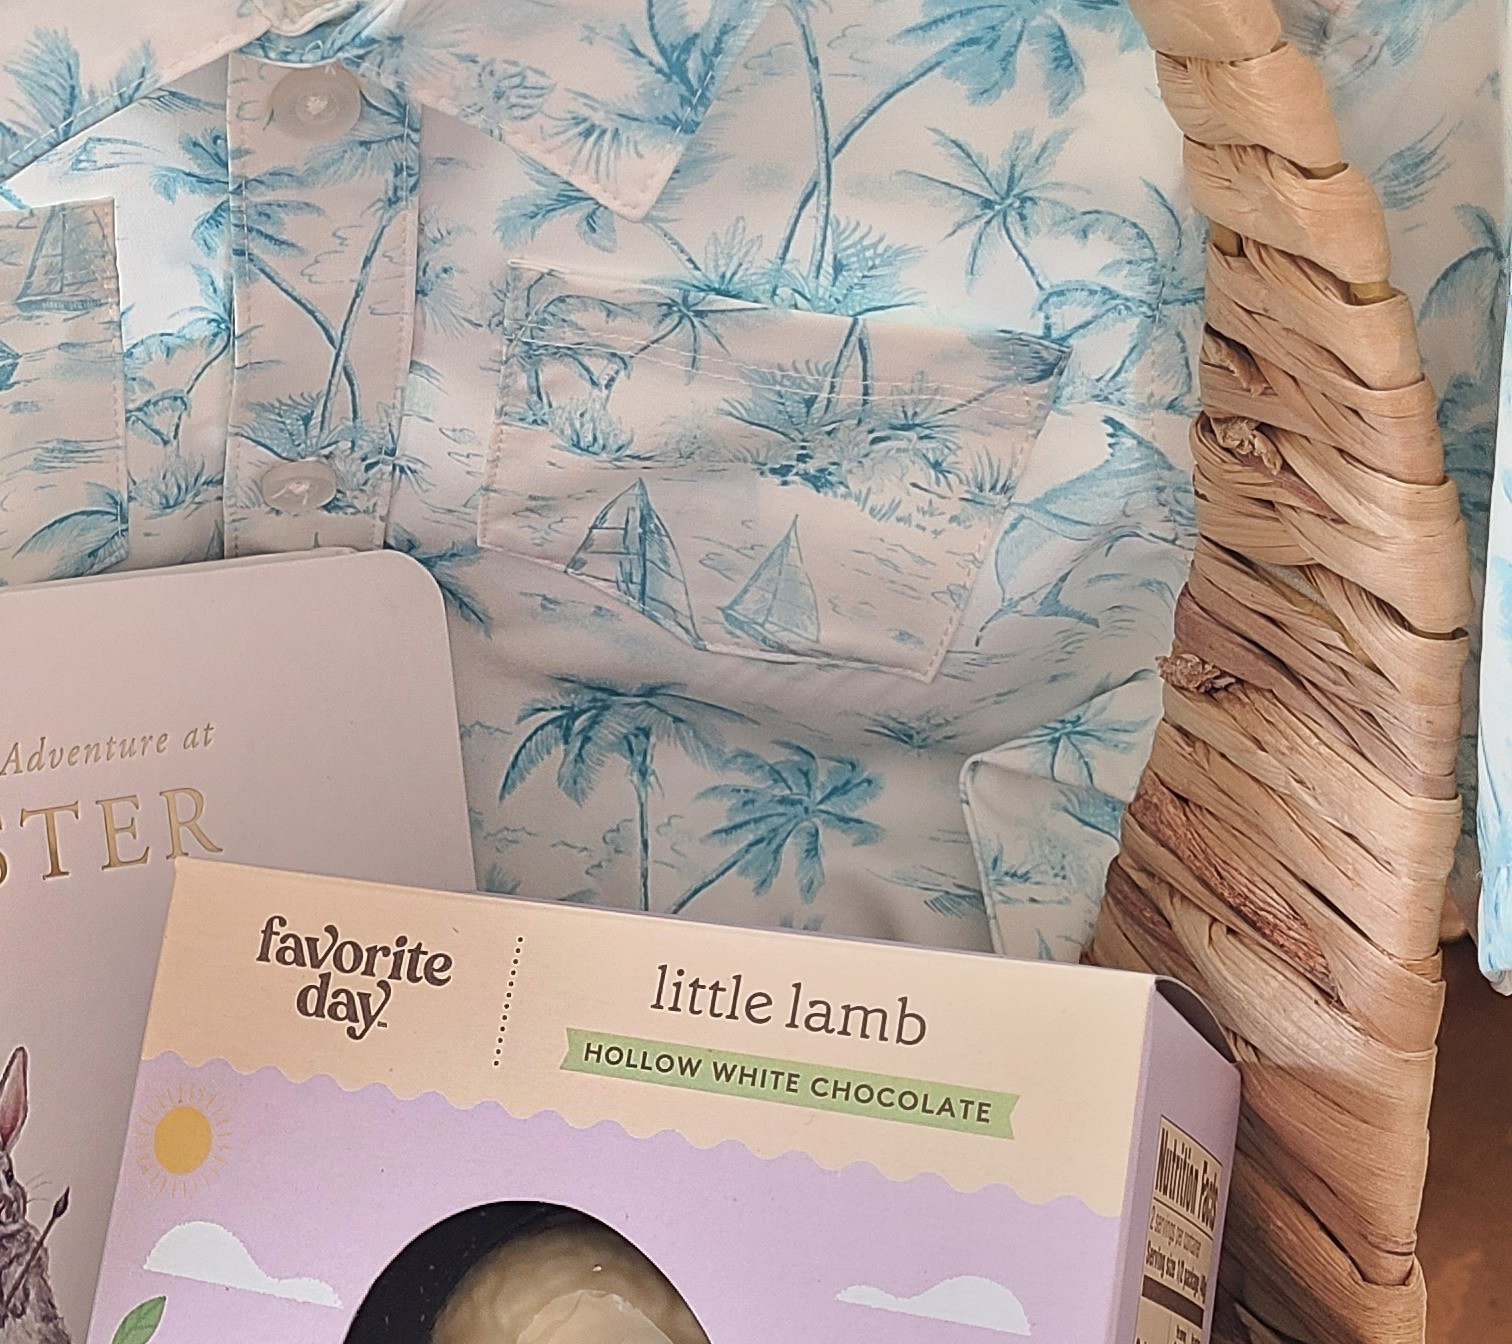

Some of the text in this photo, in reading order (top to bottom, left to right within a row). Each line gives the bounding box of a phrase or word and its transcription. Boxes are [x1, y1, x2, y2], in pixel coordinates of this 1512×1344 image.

[181, 721, 216, 750] at
[255, 914, 455, 987] favorite
[295, 971, 392, 1040] day
[649, 963, 929, 1047] little lamb
[582, 1040, 994, 1126] HOLLOW WHITE CHOCOLATE
[1155, 1127, 1219, 1233] Nutrition Facts
